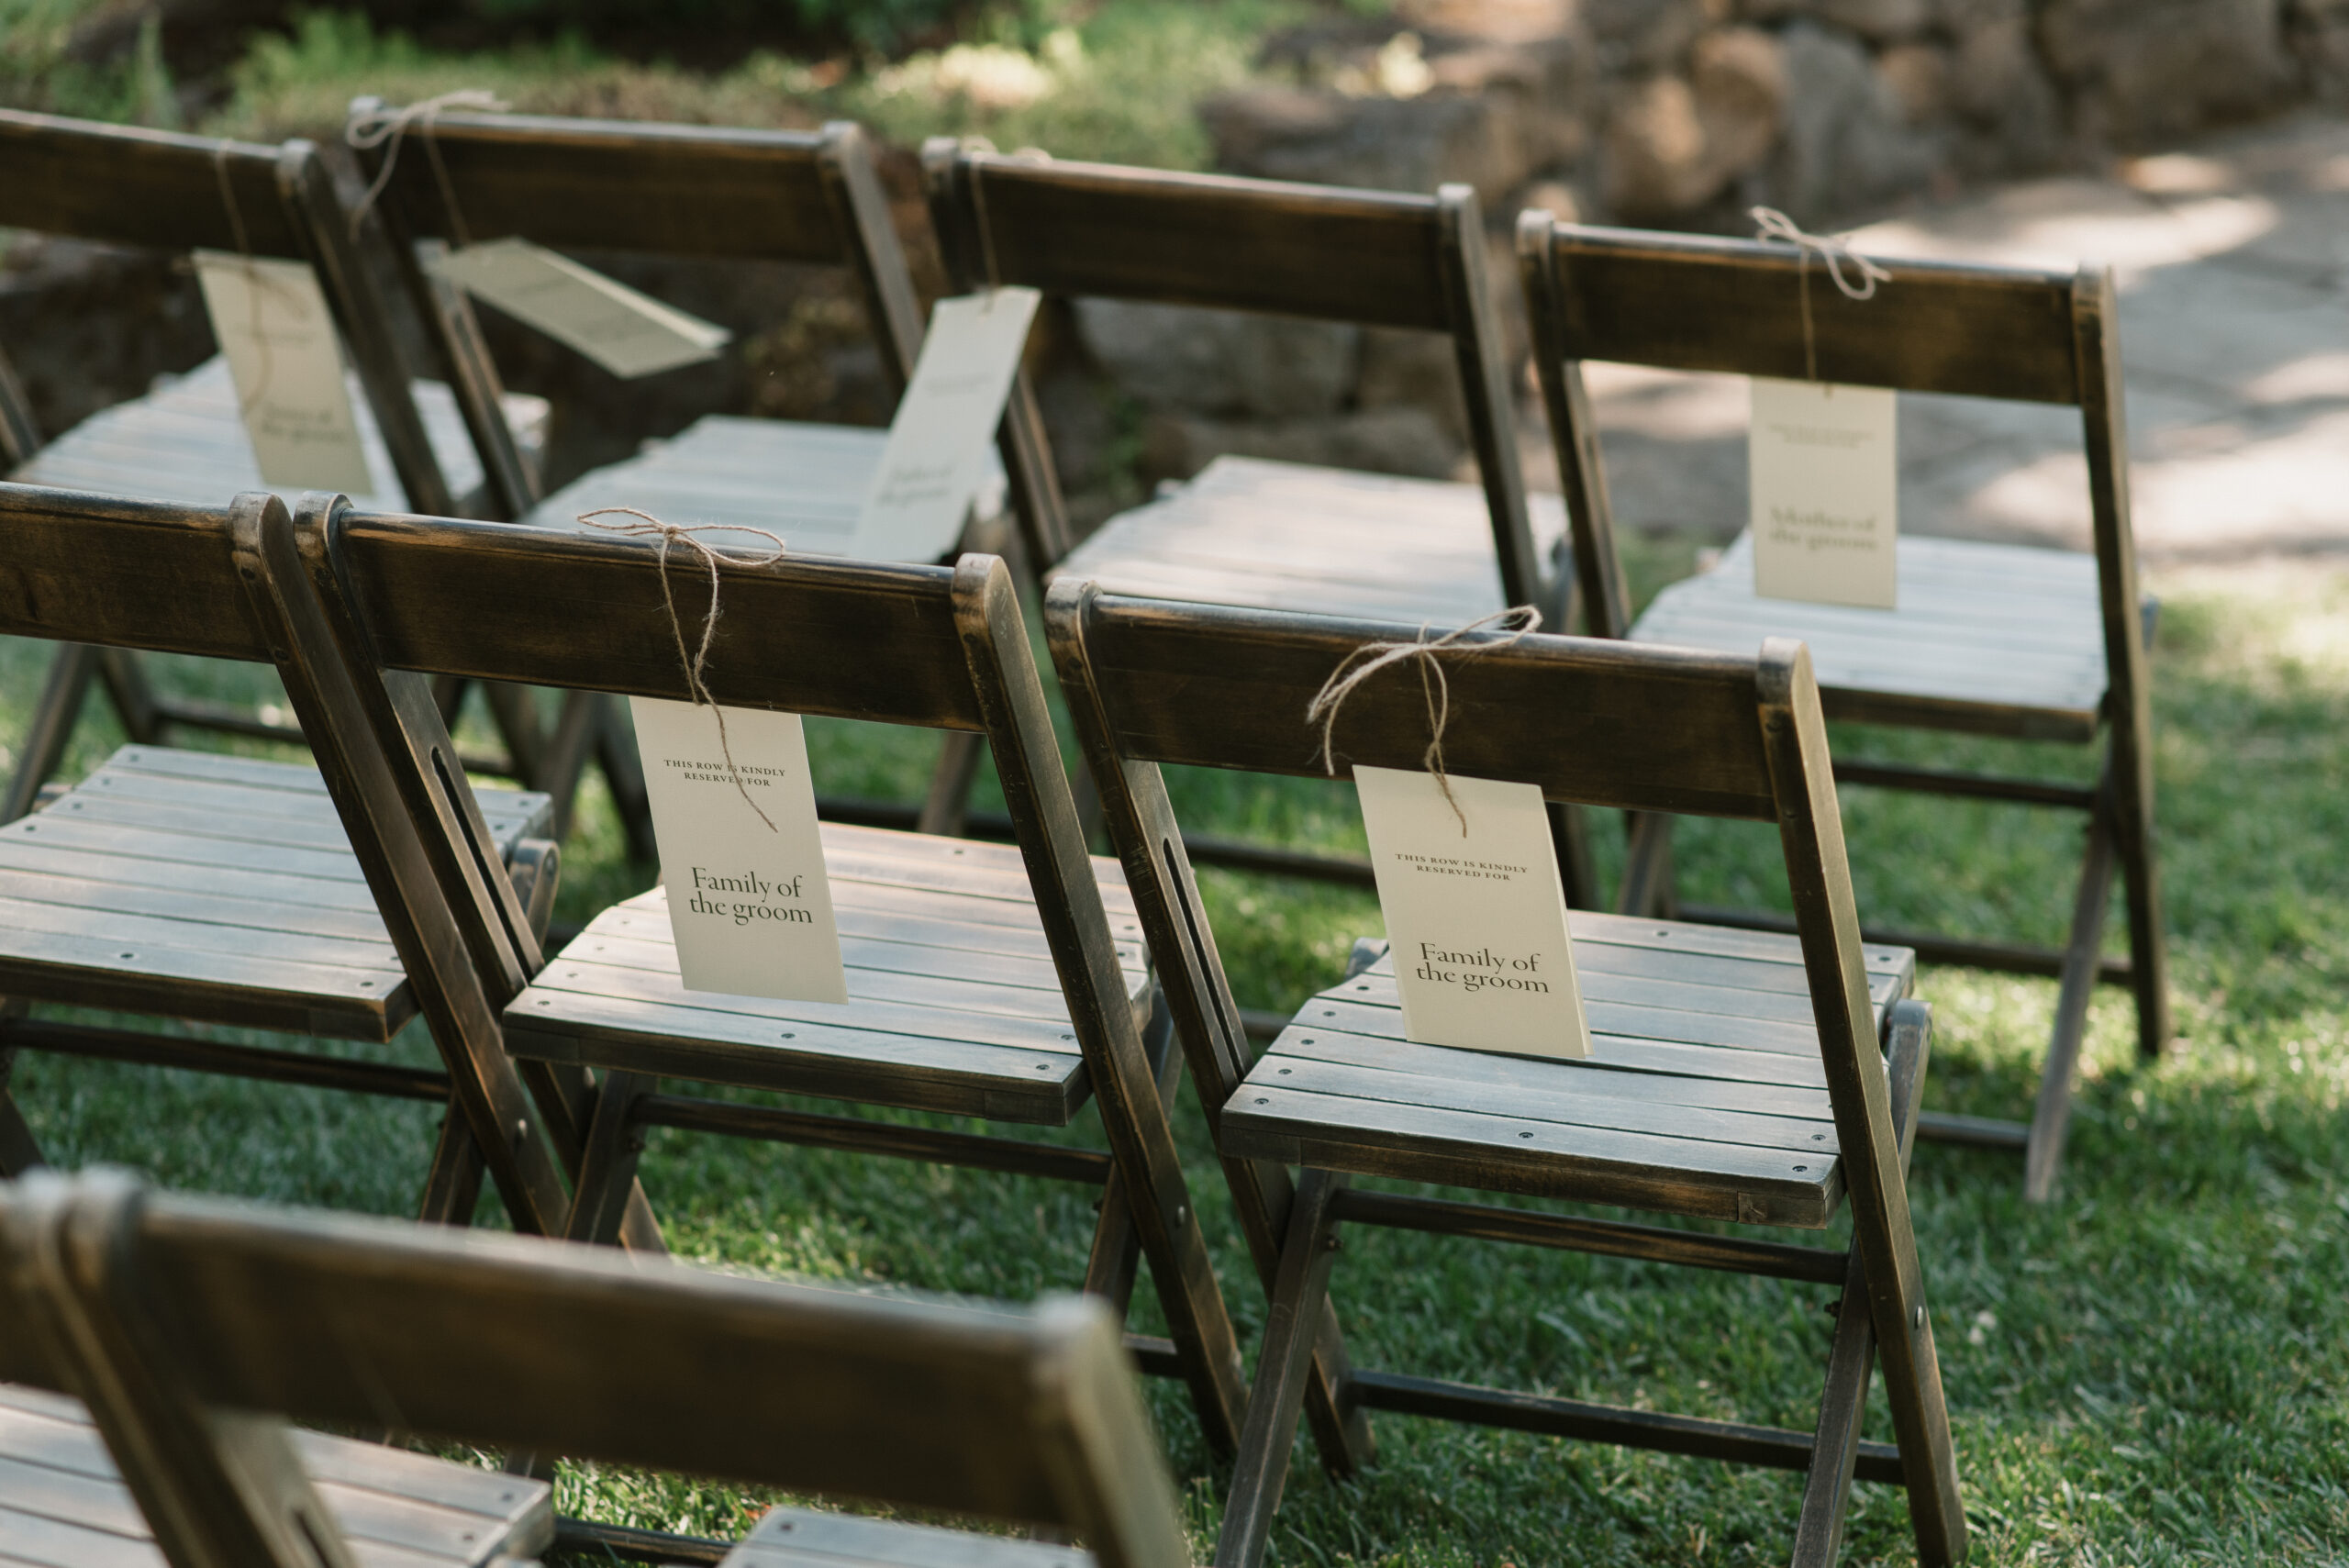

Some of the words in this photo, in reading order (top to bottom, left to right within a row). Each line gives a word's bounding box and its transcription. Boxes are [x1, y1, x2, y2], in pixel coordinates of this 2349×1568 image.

[663, 759, 693, 769] THIS
[696, 762, 723, 771] ROW
[741, 766, 785, 777] KINDLY
[747, 777, 771, 787] FOR
[1395, 853, 1426, 862] THIS
[1431, 857, 1460, 865] ROW
[1479, 862, 1528, 873] KINDLY
[1416, 864, 1481, 877] RESERVED
[1486, 872, 1511, 881] FOR
[691, 866, 771, 903] Family
[777, 874, 803, 897] of
[689, 890, 728, 916] the
[733, 903, 813, 926] groom
[1419, 942, 1506, 974] Family
[1512, 952, 1542, 972] of
[1416, 962, 1457, 983] the
[1463, 973, 1550, 994] groom
